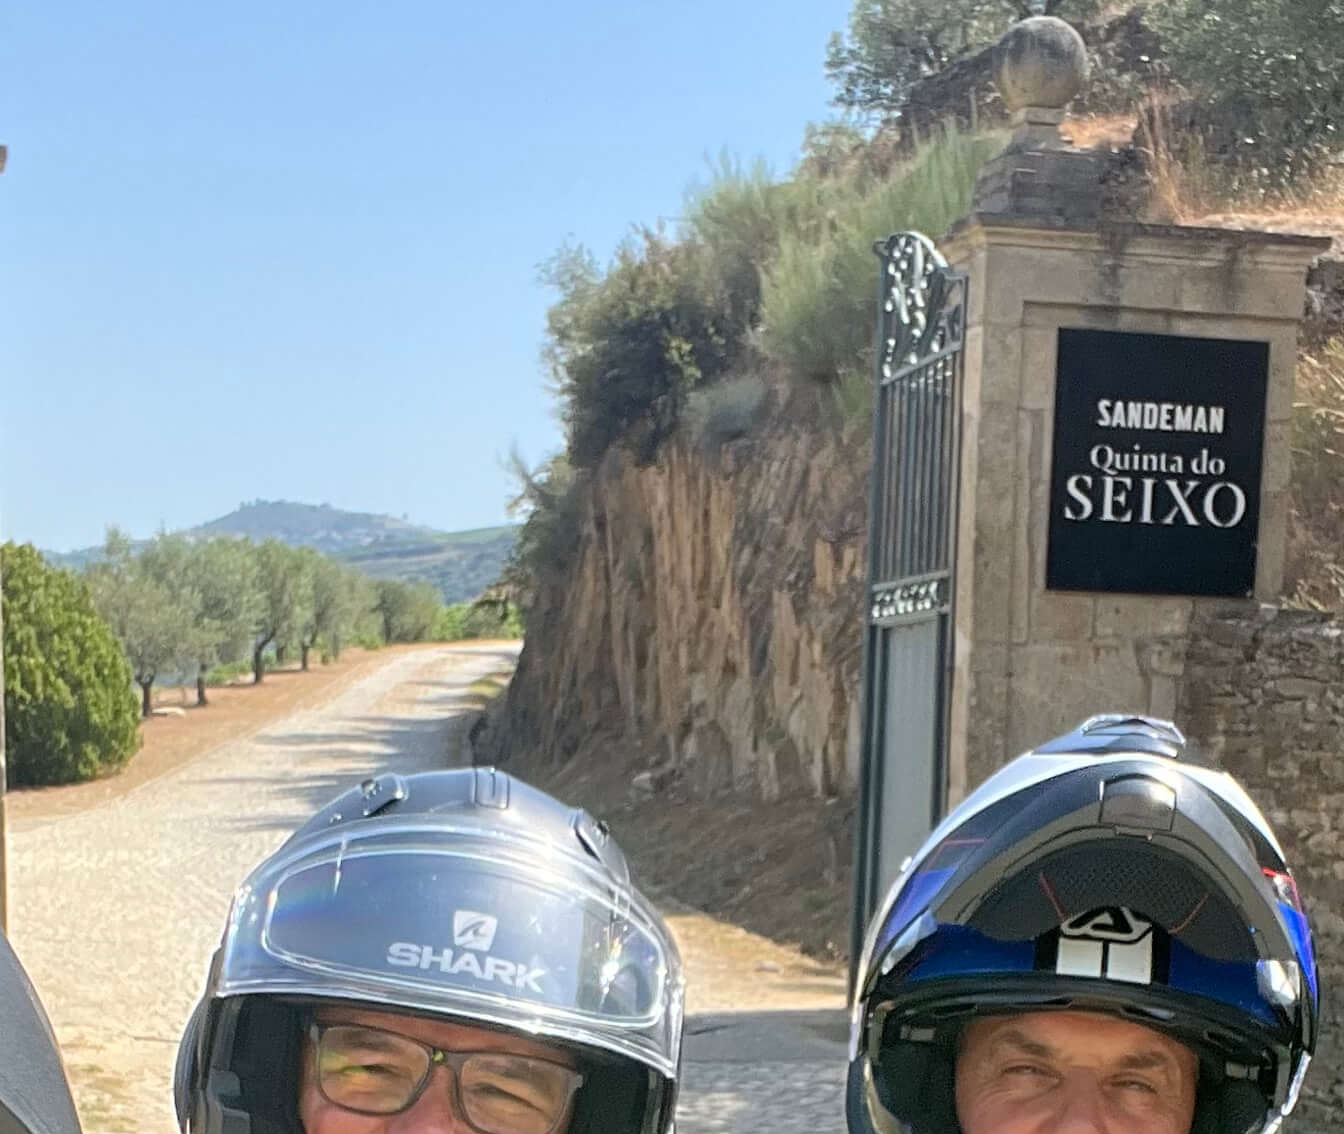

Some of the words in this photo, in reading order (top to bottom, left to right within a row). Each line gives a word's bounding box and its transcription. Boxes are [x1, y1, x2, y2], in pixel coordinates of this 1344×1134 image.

[1097, 399, 1224, 433] SANDEMAN
[1090, 444, 1183, 475] Quinta
[1191, 448, 1226, 476] do
[1064, 475, 1246, 528] SEIXO
[386, 941, 547, 993] SHARK
